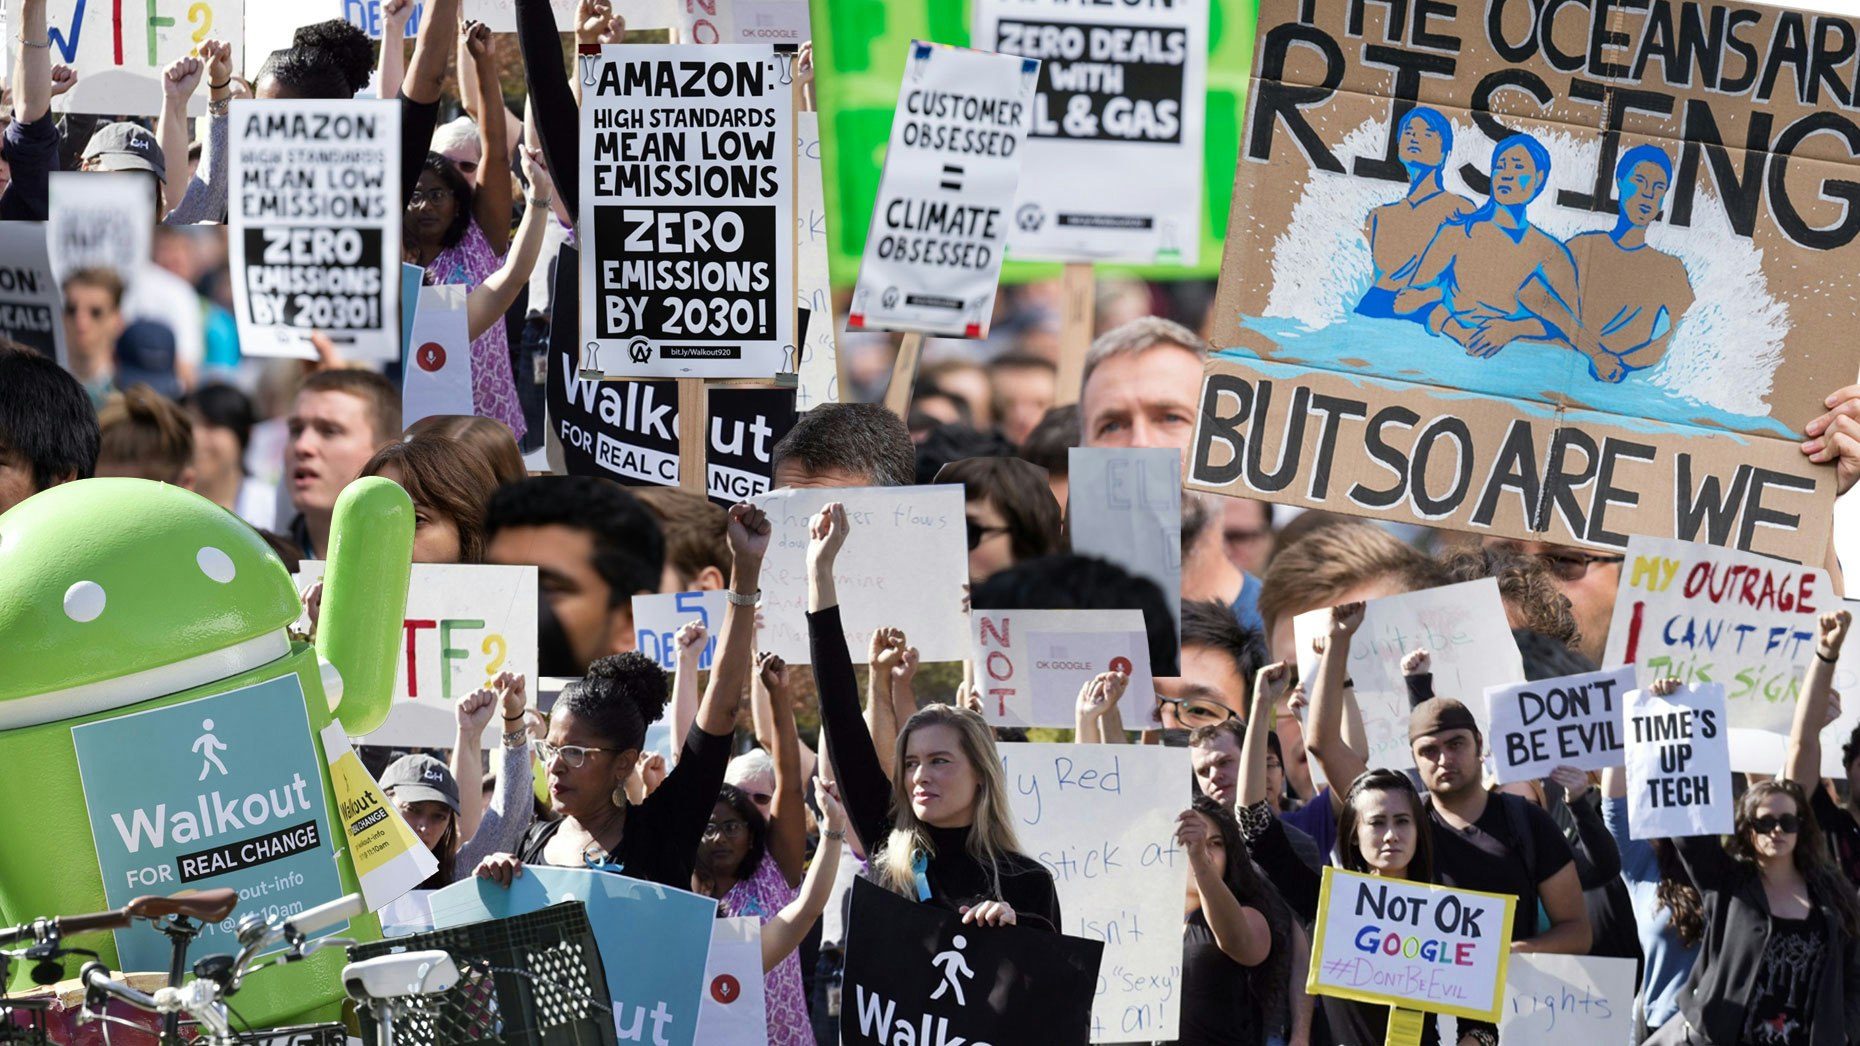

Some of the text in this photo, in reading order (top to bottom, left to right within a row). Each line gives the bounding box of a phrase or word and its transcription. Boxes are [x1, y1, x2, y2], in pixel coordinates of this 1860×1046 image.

[758, 30, 798, 38] GOOGLE
[1000, 23, 1186, 66] ZERO DEALS
[596, 60, 776, 98] AMAZON:
[1050, 61, 1124, 95] WITH
[594, 107, 776, 129] HIGH STANDARDS
[906, 91, 1023, 127] CUSTOMER
[1063, 94, 1099, 137] &
[1101, 96, 1179, 139] GAS
[594, 132, 686, 162] MEAN
[701, 131, 776, 160] LOW
[903, 122, 1016, 157] OBSESSED
[1249, 22, 1860, 250] RISING
[242, 168, 385, 191] MEAN LOW
[594, 164, 779, 198] EMISSIONS
[242, 193, 387, 219] EMISSIONS
[886, 199, 1000, 239] CLIMATE
[263, 229, 364, 266] ZERO
[622, 209, 745, 253] ZERO
[877, 236, 991, 271] OBSESSED
[249, 266, 382, 296] EMISSIONS
[603, 259, 769, 293] EMISSIONS
[251, 295, 380, 328] BY 2030!
[605, 295, 649, 334] BY
[661, 296, 767, 336] 2030!
[670, 348, 731, 358] bit.ly/Walkout920
[562, 352, 773, 464] Walkut
[561, 419, 592, 455] FOR
[600, 441, 651, 476] REAL
[1192, 374, 1817, 566] BUT SO ARE WE
[1630, 556, 1817, 614] MY OUTRAGE
[1663, 615, 1757, 654] CAN'T
[1036, 661, 1093, 671] OK GOOGLE
[1518, 679, 1616, 726] DON'T
[1505, 720, 1624, 767] BE EVIL
[1632, 709, 1717, 744] TIME'S
[1055, 755, 1122, 795] Red
[1660, 743, 1692, 774] UP
[1646, 775, 1710, 808] TECH
[111, 772, 312, 854] Walkout
[125, 825, 318, 890] FOR REAL CHANGE
[1355, 882, 1428, 927] NOT
[1354, 925, 1476, 966] GOOGLE
[1512, 985, 1613, 1033] rights
